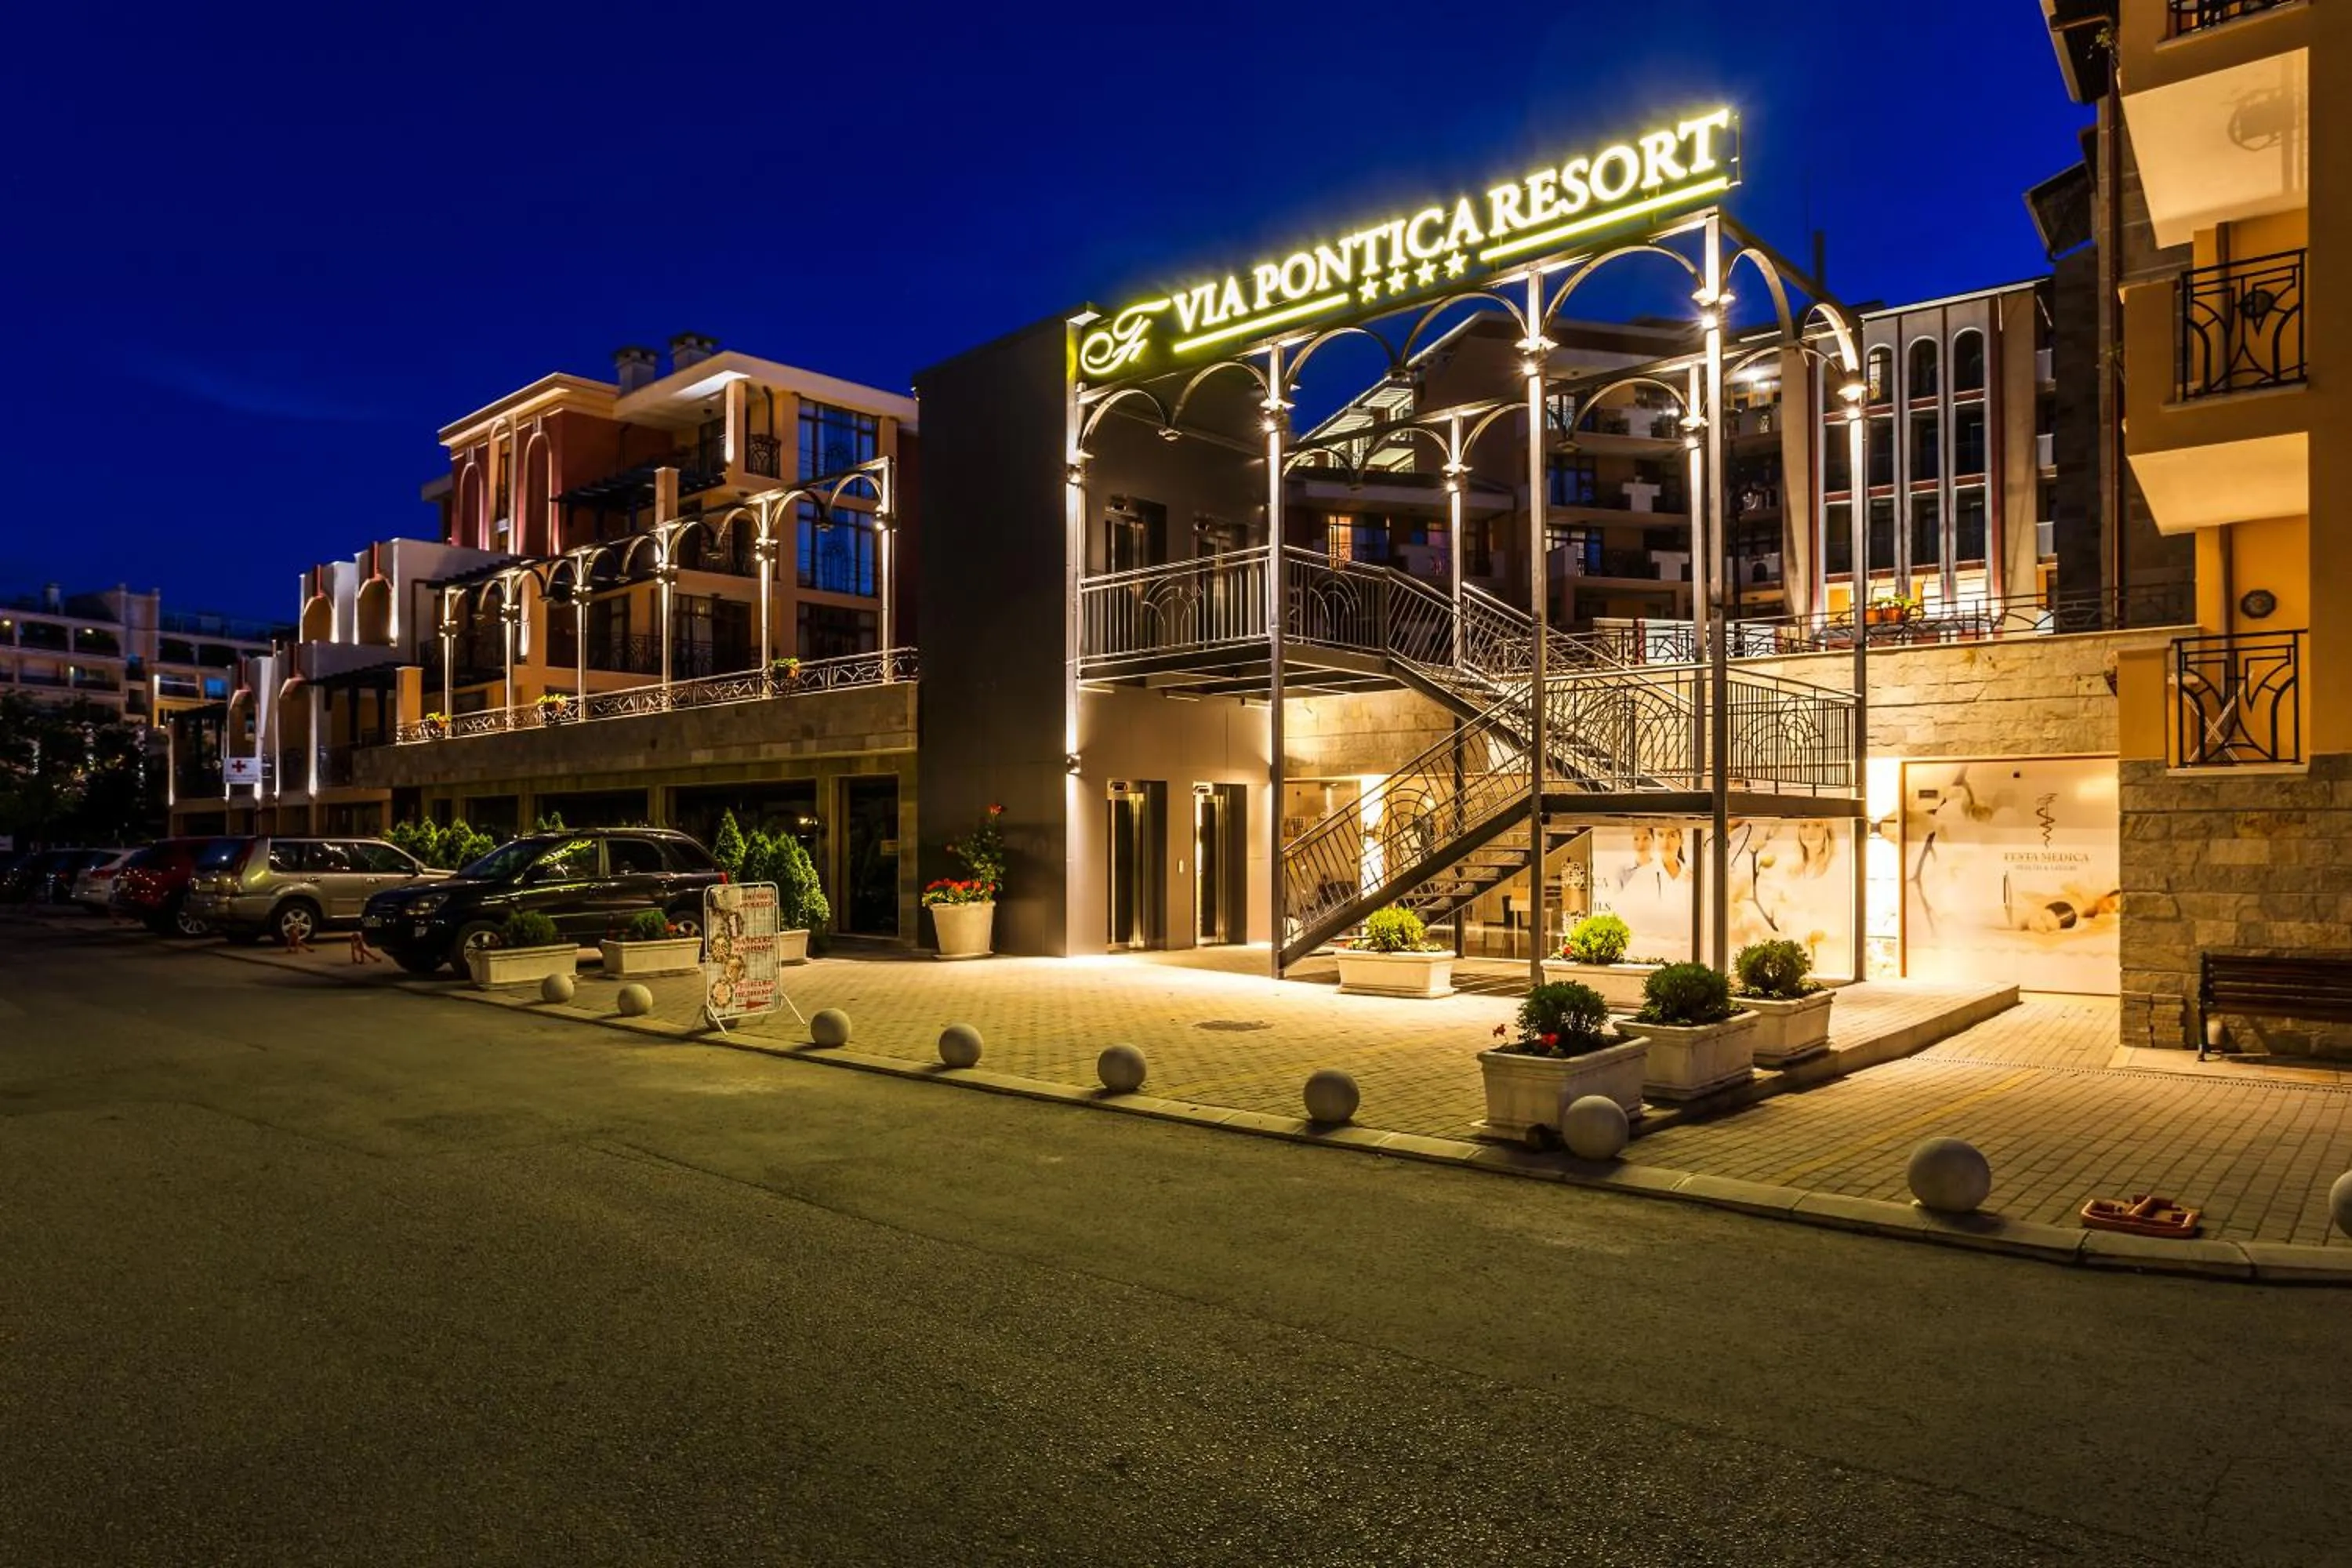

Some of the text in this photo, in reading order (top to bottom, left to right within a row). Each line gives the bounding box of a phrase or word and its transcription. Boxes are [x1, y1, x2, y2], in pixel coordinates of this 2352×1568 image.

[1173, 275, 1249, 333] VIA
[1254, 198, 1484, 310] PONTICA
[1487, 108, 1730, 237] RESORT
[2041, 851, 2089, 862] MEDICA
